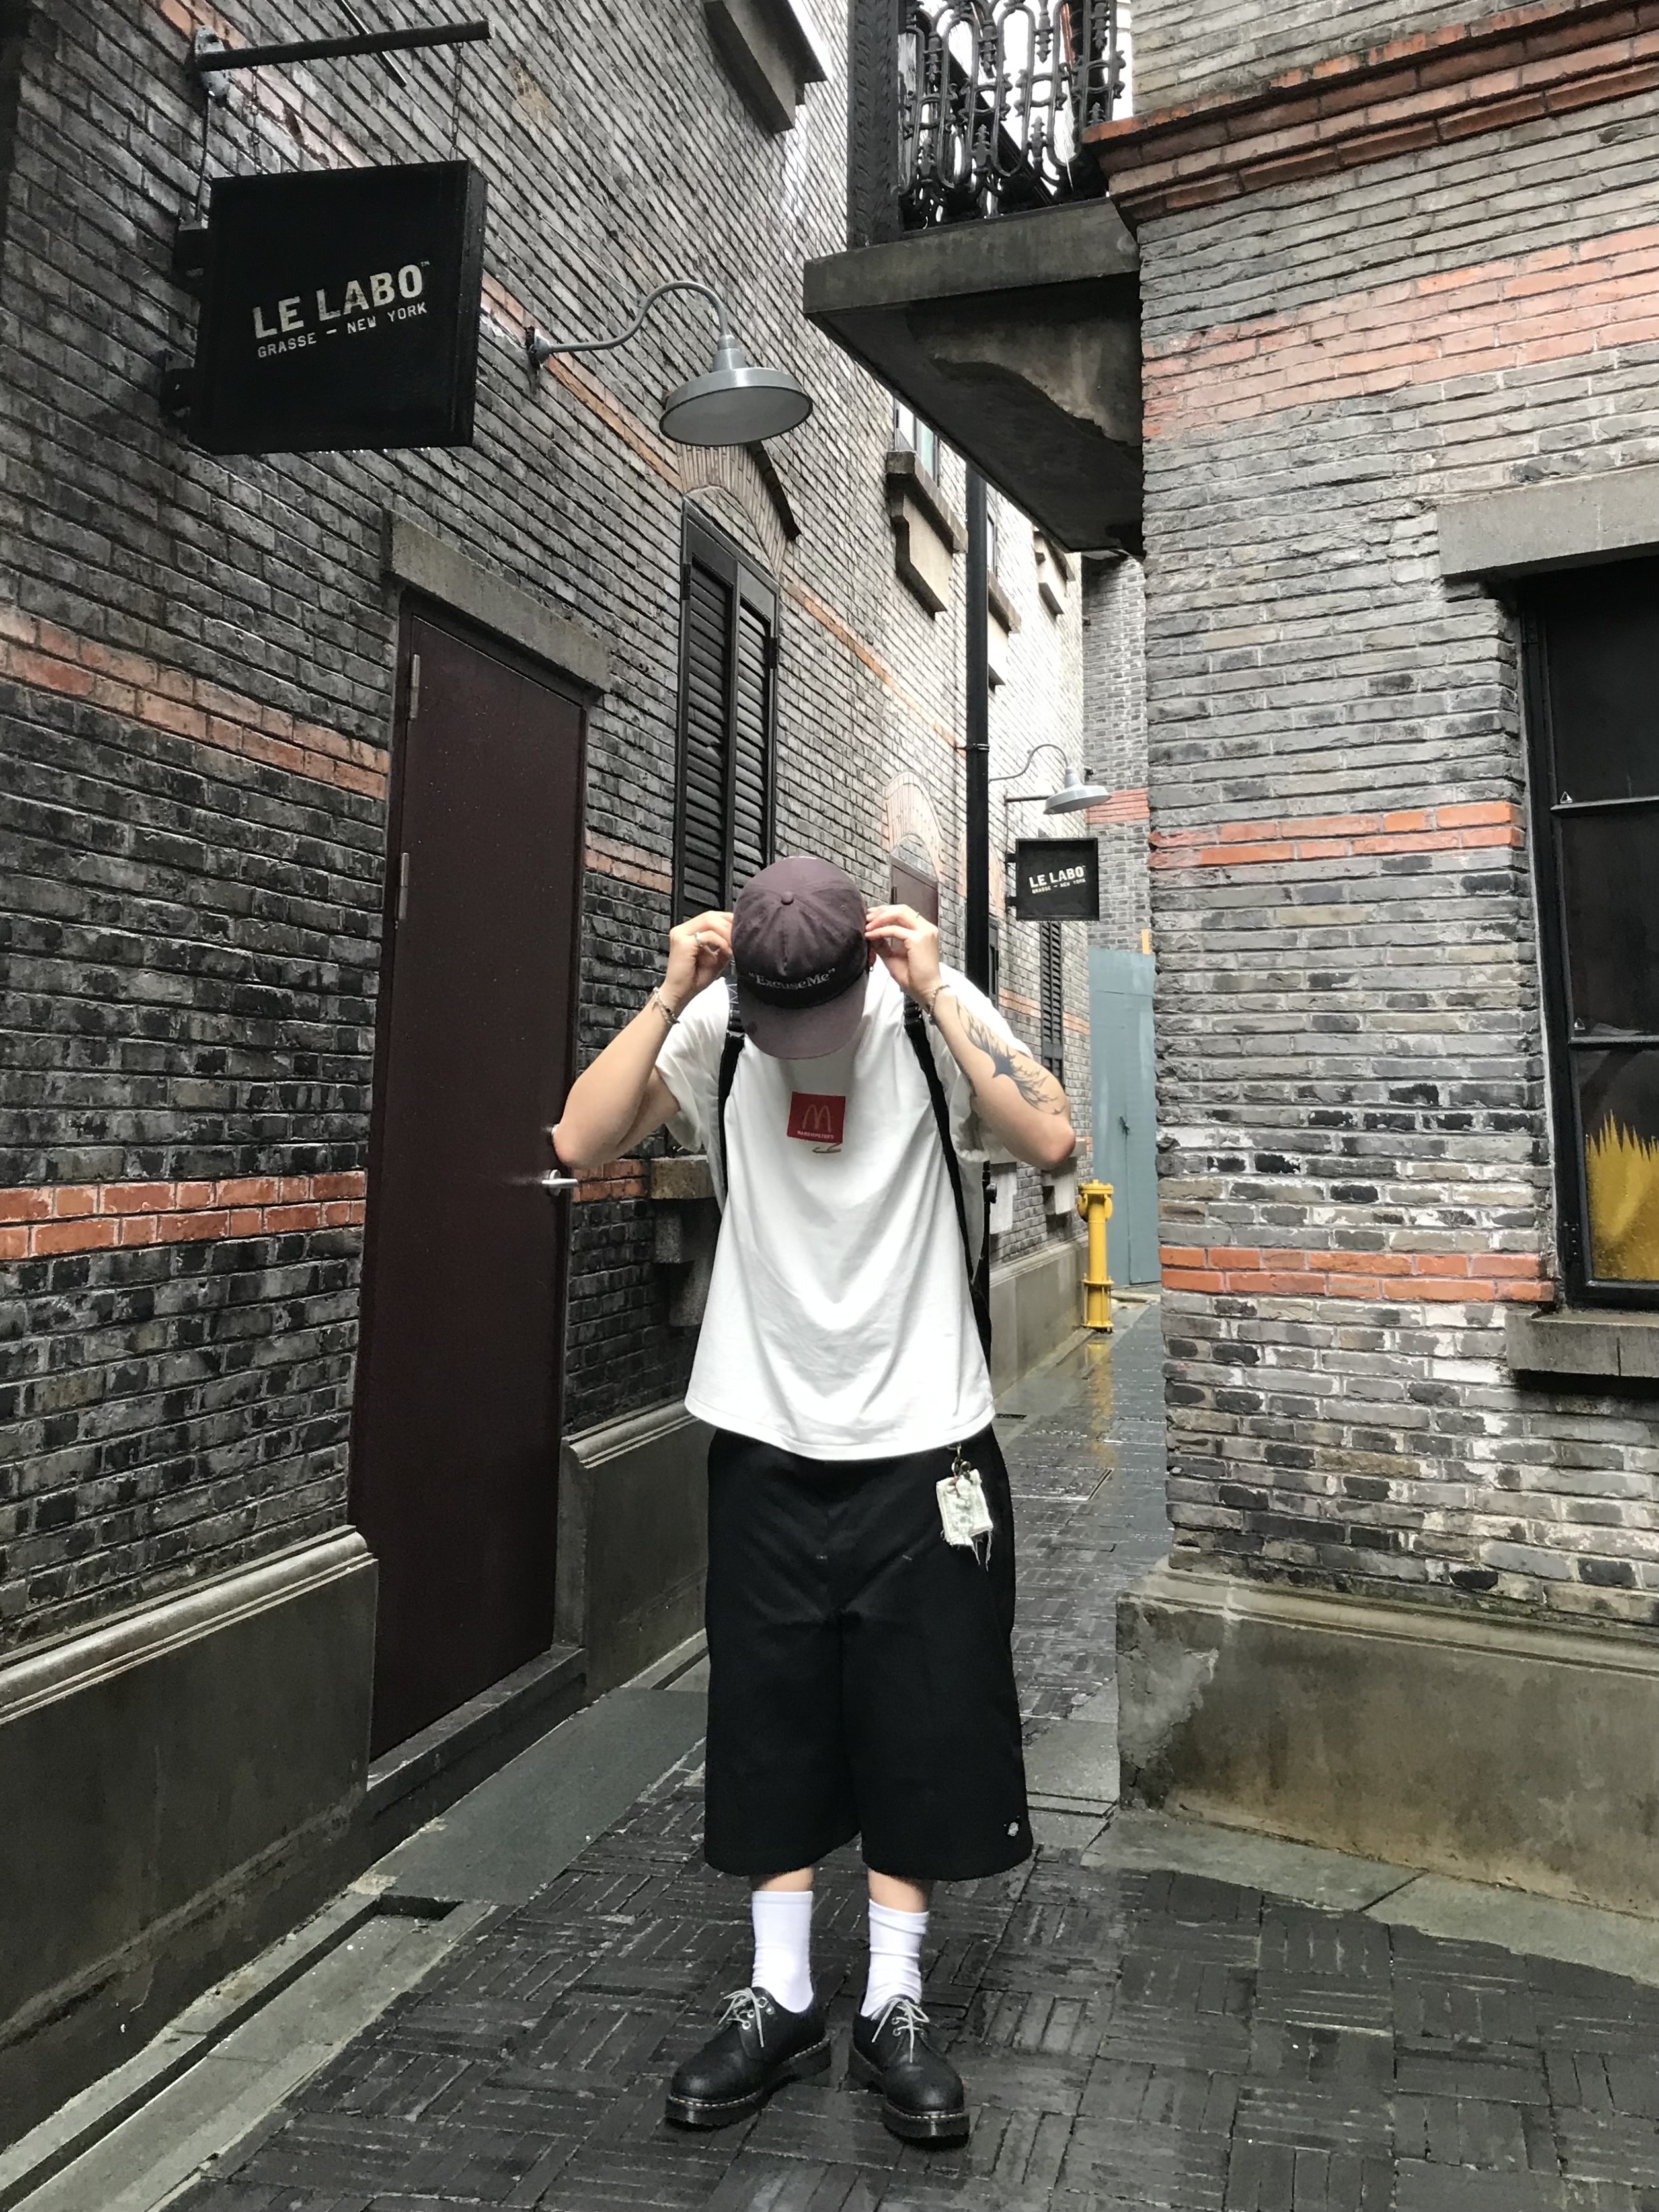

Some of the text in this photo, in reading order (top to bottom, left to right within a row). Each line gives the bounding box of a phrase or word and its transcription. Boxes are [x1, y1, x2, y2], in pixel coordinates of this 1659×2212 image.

[252, 295, 304, 339] LE
[315, 264, 423, 322] LABO
[257, 332, 317, 358] GRASSE
[347, 316, 377, 334] NEW
[387, 301, 428, 323] YORK
[1028, 866, 1085, 888] LE LABO
